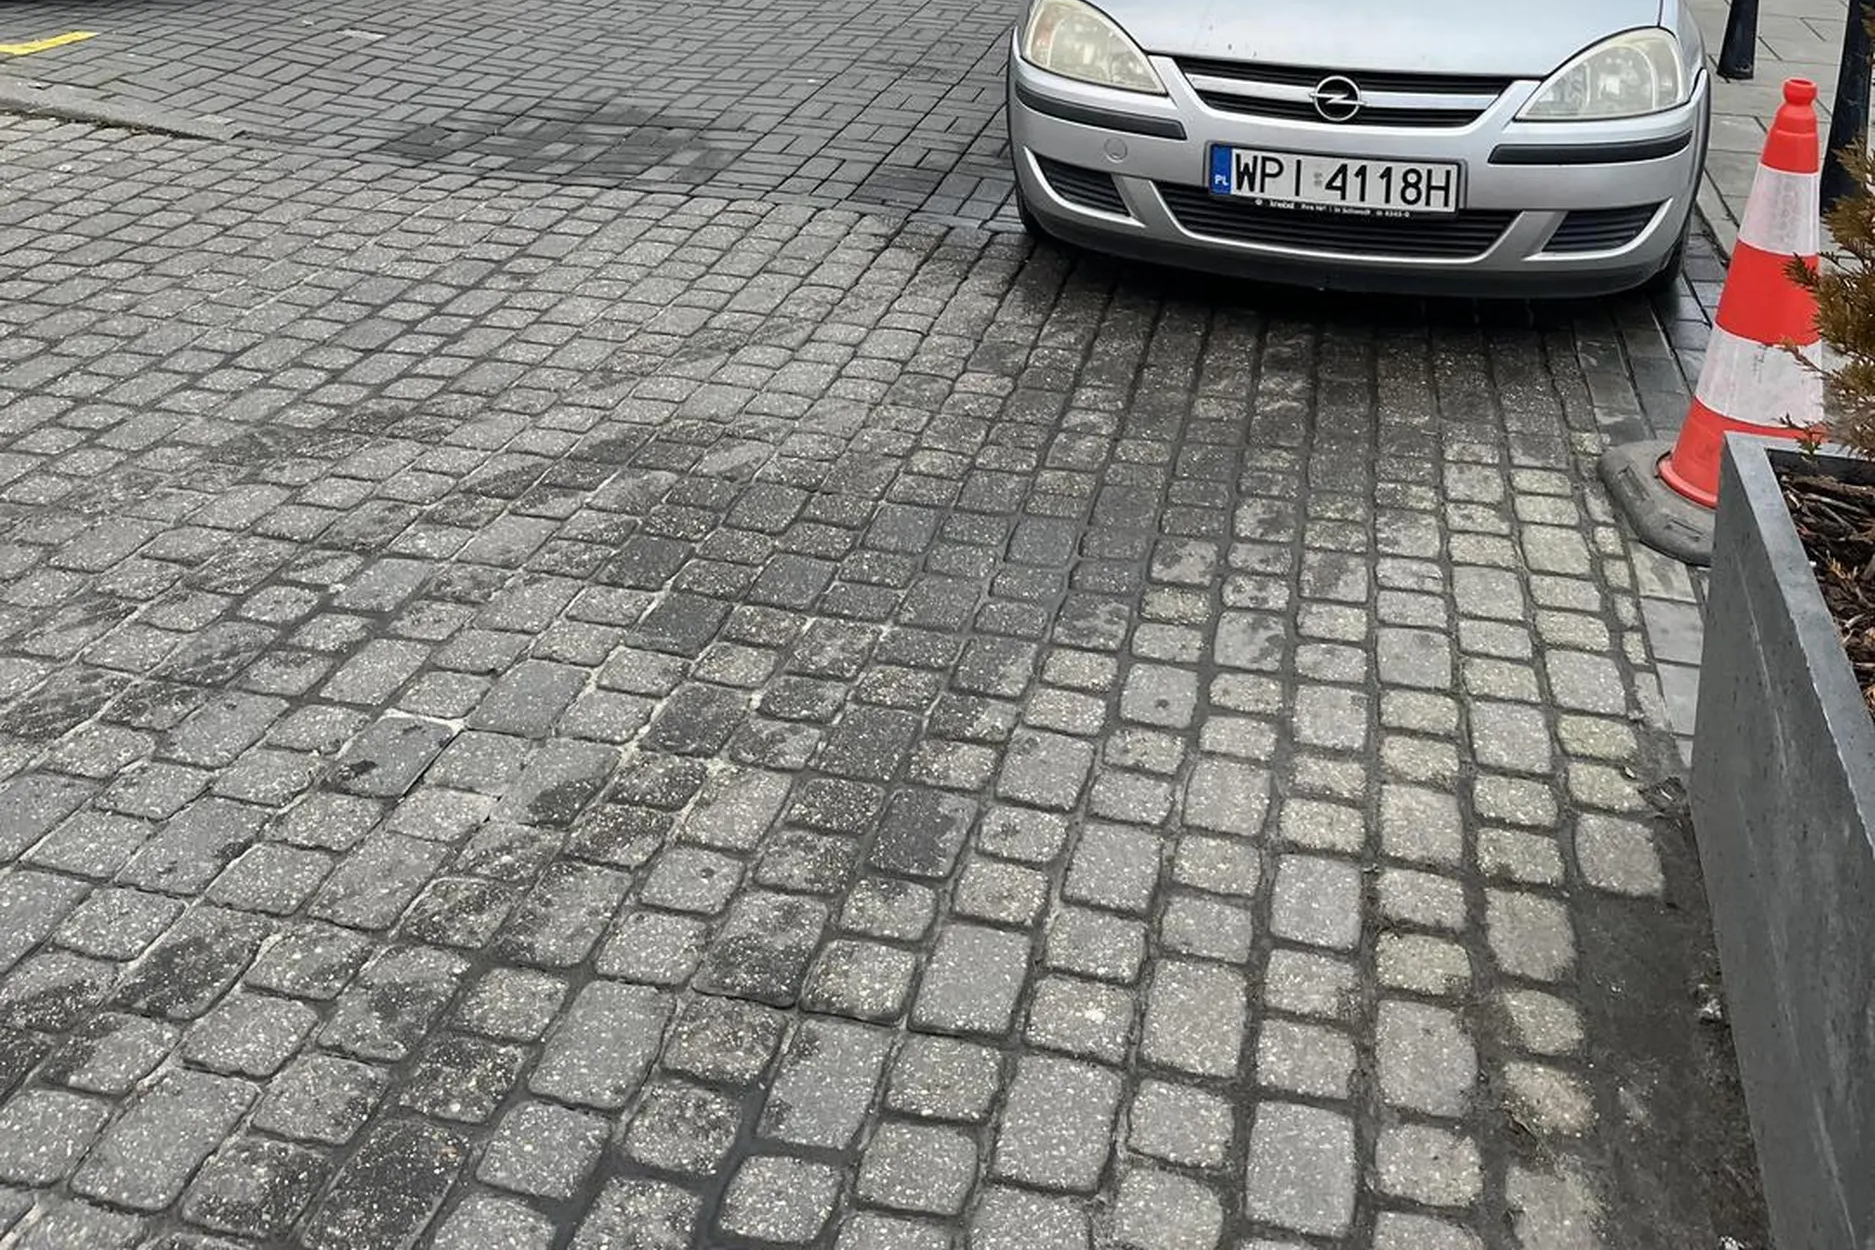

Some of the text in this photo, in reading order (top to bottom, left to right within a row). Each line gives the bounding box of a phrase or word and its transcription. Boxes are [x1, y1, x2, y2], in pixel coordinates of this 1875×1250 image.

[1214, 174, 1230, 187] PL
[1235, 153, 1452, 208] WPI 4118H
